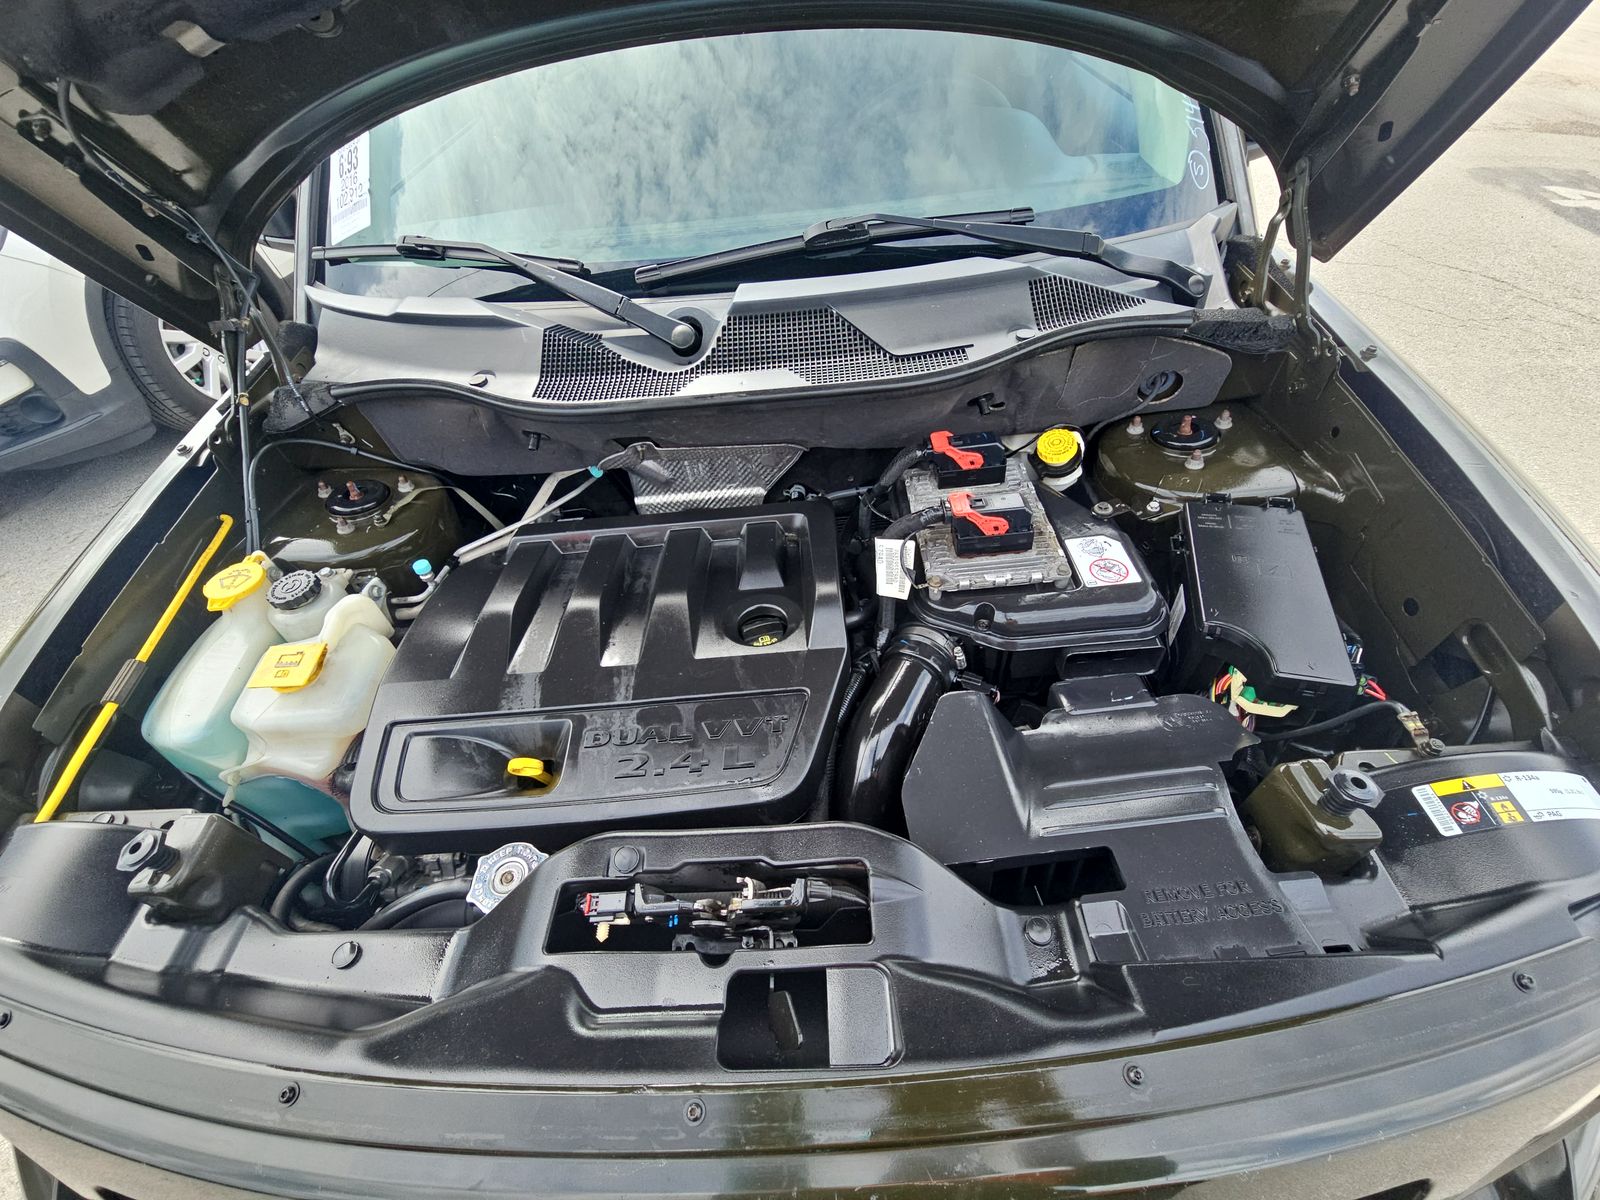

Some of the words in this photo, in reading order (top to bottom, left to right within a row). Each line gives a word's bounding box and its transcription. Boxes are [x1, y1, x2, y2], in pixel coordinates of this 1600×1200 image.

[584, 722, 693, 749] DUAL
[701, 714, 789, 740] VVT
[1144, 882, 1214, 904] REMOVE
[1216, 880, 1253, 897] FOR
[1140, 906, 1210, 928] BATTERY
[1216, 898, 1284, 921] ACCESS
